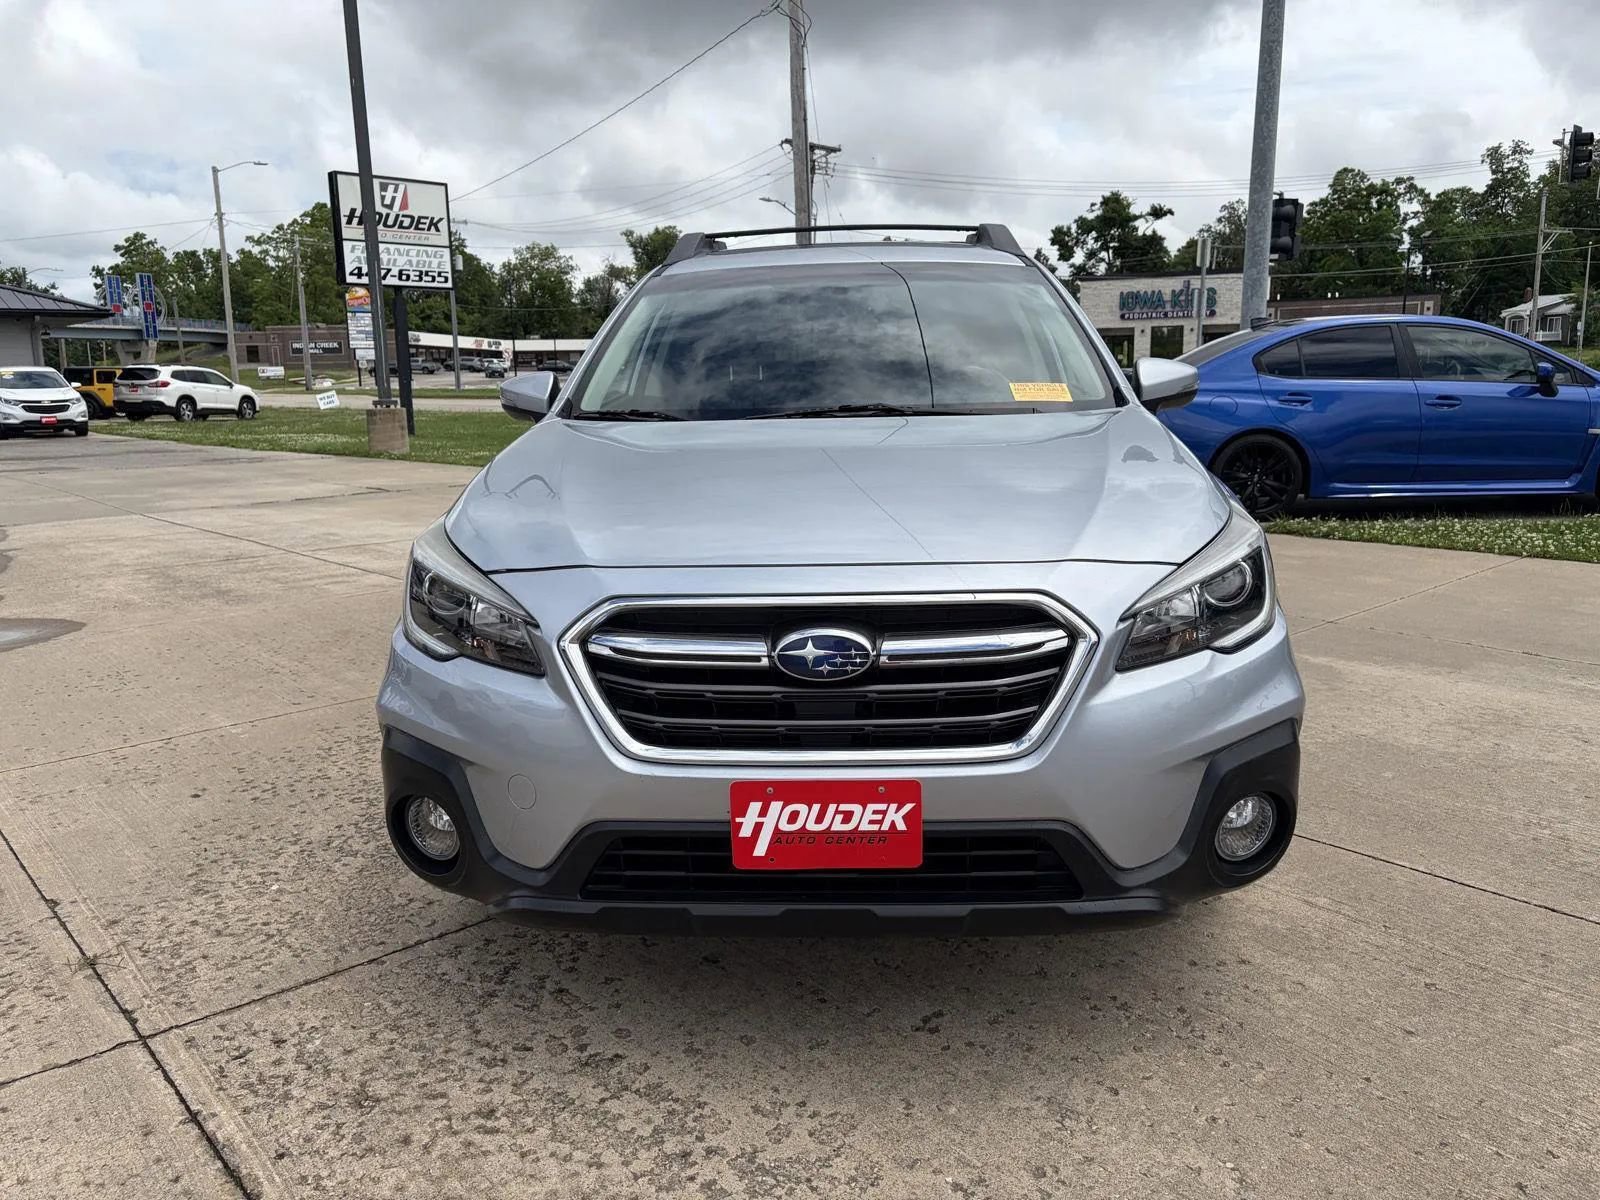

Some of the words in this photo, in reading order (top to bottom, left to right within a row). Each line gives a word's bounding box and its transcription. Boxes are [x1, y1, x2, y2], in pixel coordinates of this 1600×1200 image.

[350, 245, 445, 259] FIANCING
[349, 267, 449, 283] 47-6355
[1119, 290, 1165, 311] IOWA
[1124, 311, 1165, 319] PEDIATRIC
[735, 801, 916, 857] HOUDEK
[774, 836, 816, 845] AUTO
[825, 836, 887, 845] CENTER
